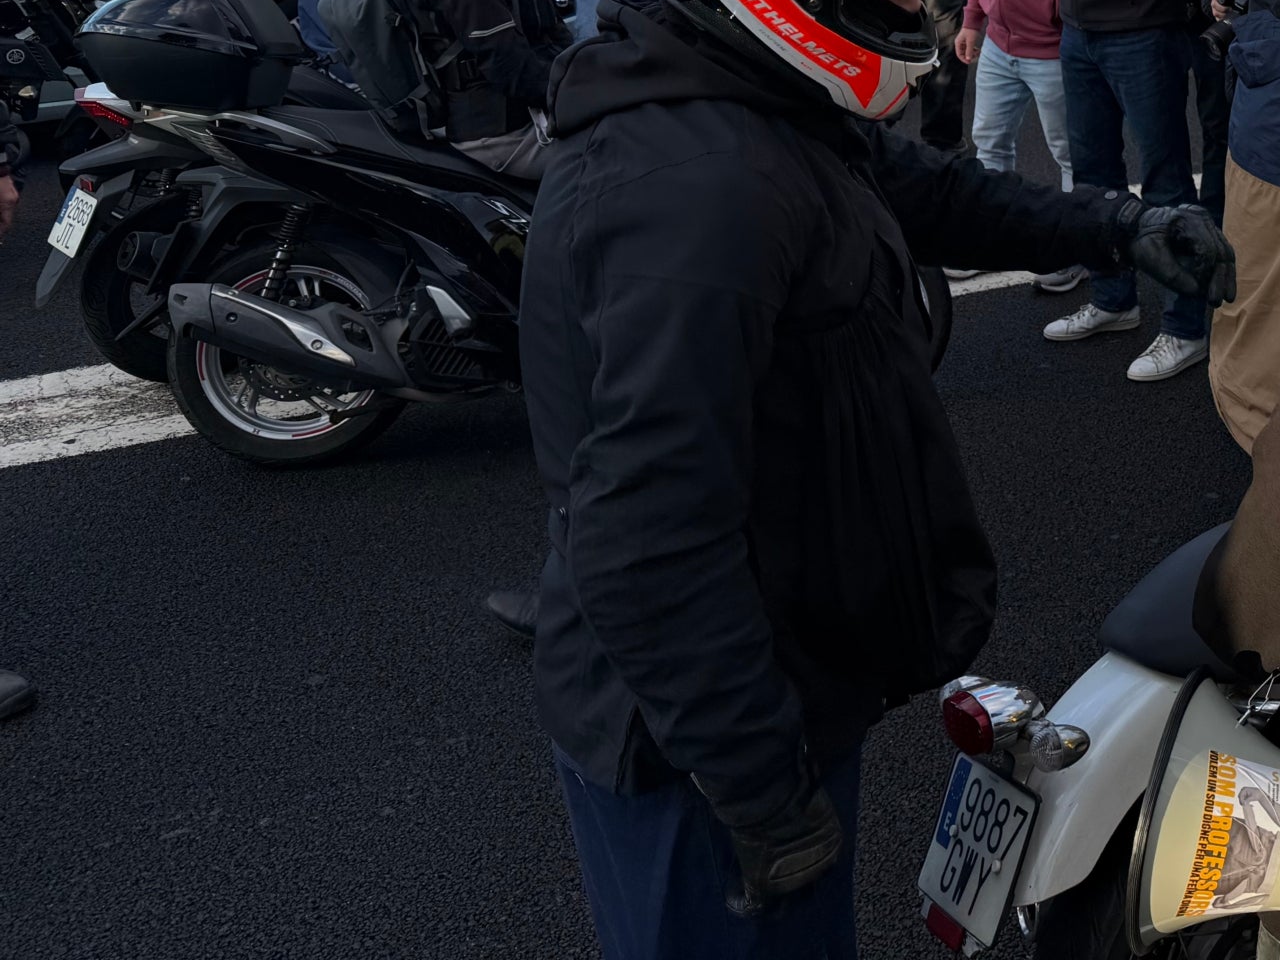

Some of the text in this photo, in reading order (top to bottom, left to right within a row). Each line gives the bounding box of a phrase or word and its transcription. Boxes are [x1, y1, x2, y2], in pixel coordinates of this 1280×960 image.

[67, 196, 93, 227] 2663
[1208, 750, 1219, 778] VOLEM
[1207, 779, 1217, 792] UN
[1204, 793, 1215, 812] SOU
[960, 778, 1029, 861] 9887
[1199, 813, 1213, 842] DIGNE
[1184, 753, 1238, 917] SOM PROFESSORS
[1195, 843, 1208, 861] PER
[940, 838, 993, 916] GWY
